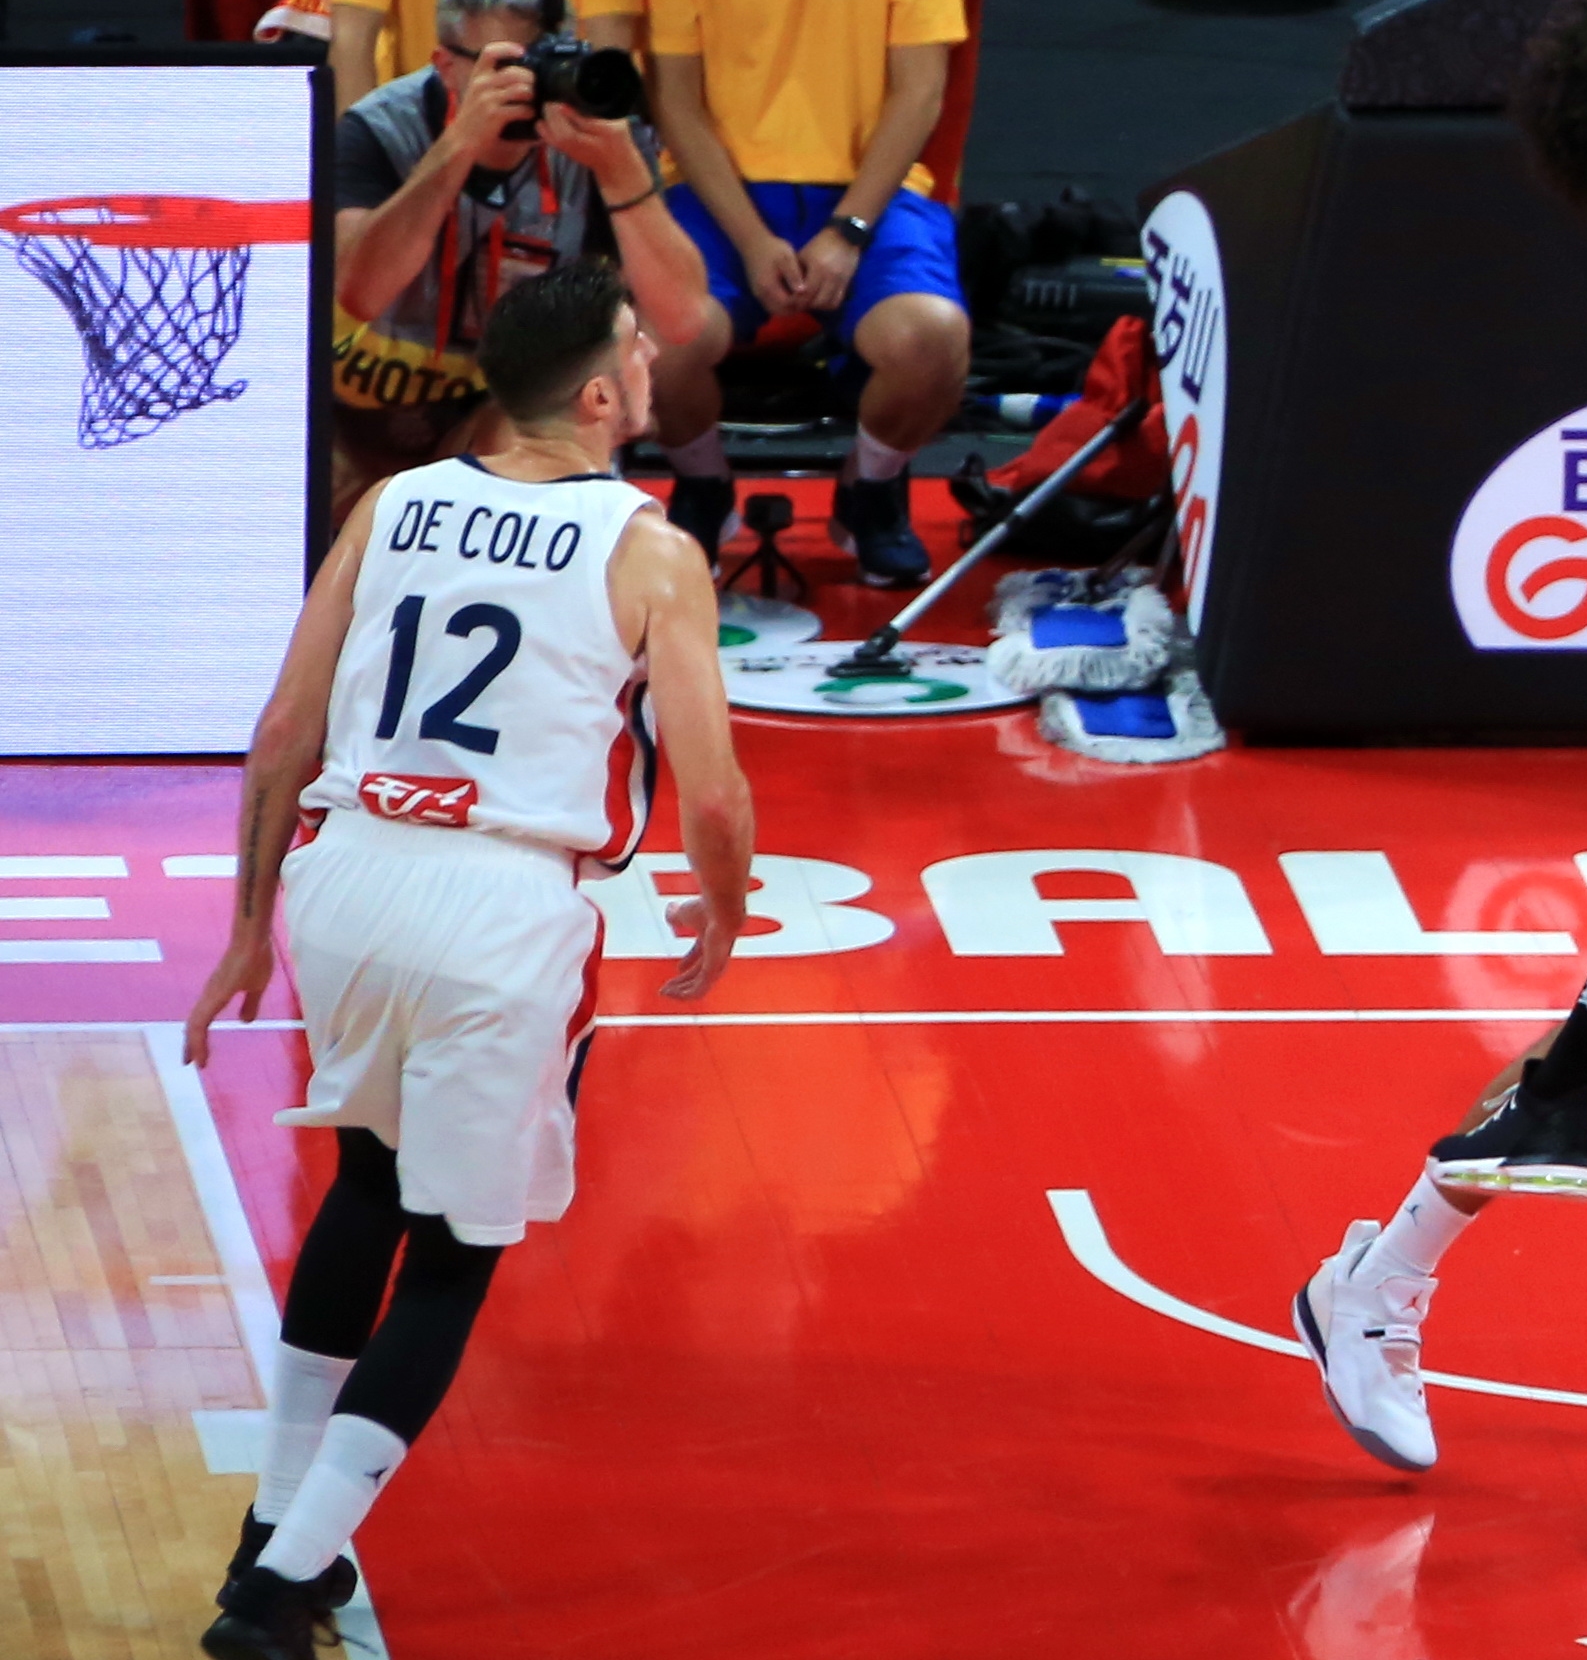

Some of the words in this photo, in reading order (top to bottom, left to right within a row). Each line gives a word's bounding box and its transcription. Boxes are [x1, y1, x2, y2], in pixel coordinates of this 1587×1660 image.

[388, 499, 455, 553] DE
[457, 505, 583, 572] COLO
[373, 594, 523, 756] 12
